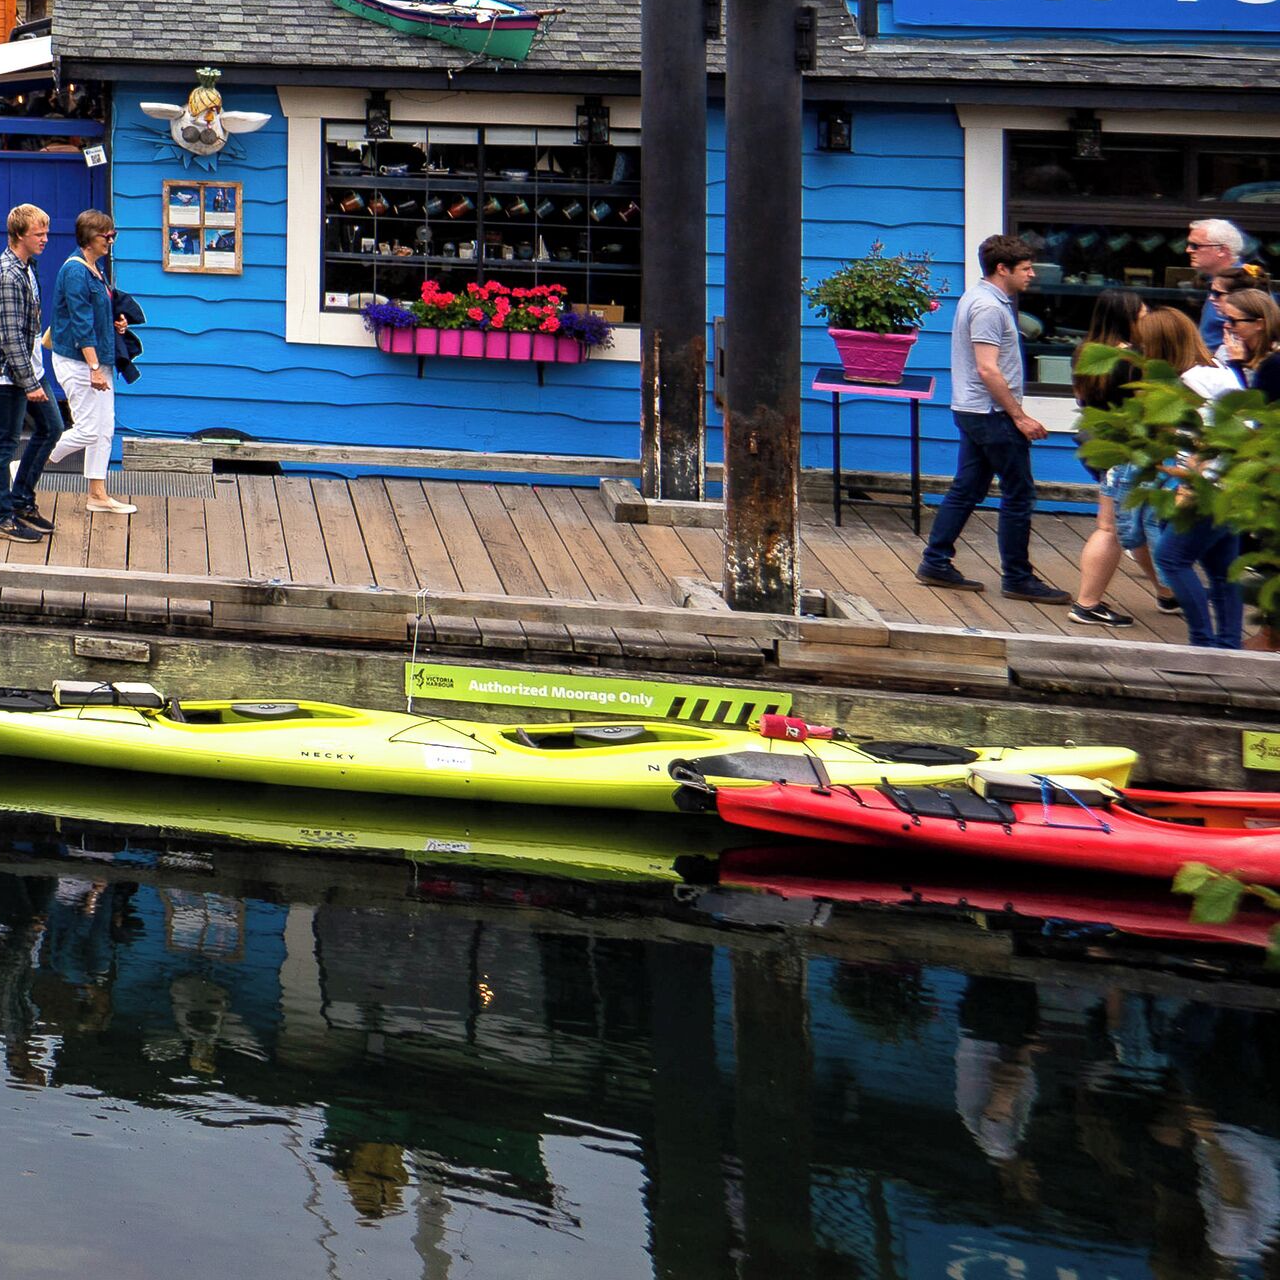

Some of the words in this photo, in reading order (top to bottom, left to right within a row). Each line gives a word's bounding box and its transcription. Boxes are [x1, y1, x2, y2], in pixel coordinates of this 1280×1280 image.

[468, 679, 548, 698] Authorized
[551, 686, 616, 705] Moorage
[619, 691, 654, 708] Only
[301, 751, 355, 760] NECKY
